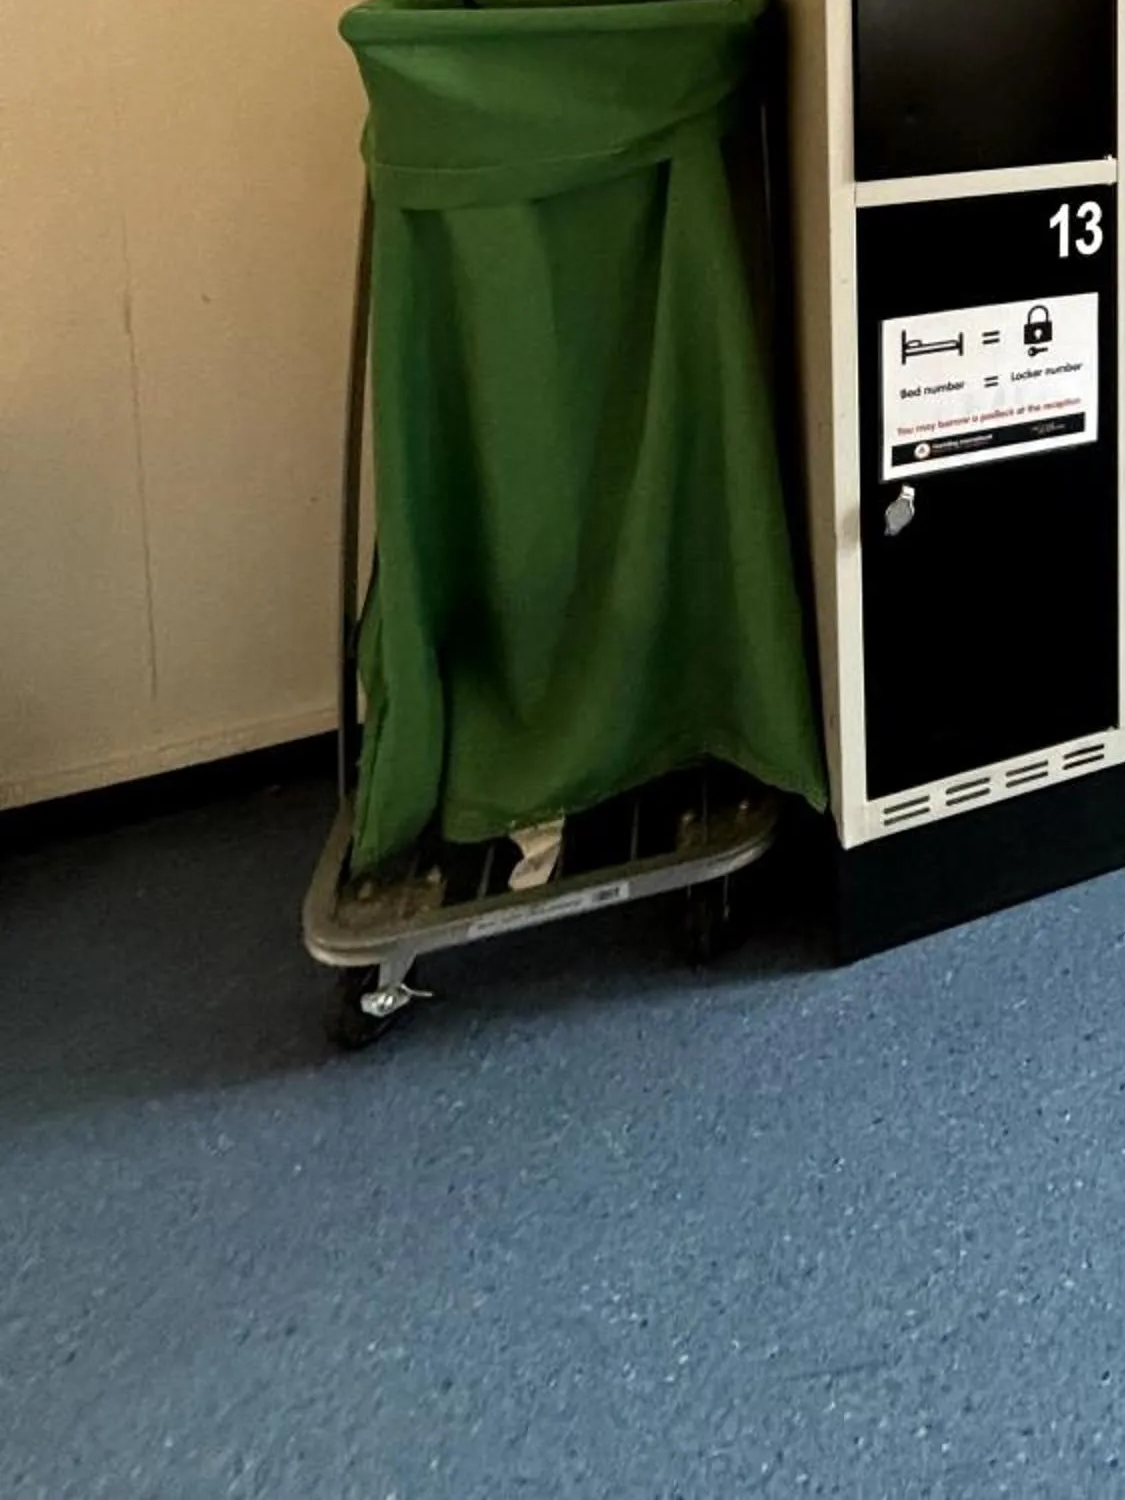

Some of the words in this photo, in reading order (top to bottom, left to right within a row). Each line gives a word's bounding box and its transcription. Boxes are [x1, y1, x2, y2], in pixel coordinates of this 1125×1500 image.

[1049, 201, 1103, 258] 13
[899, 385, 920, 398] Bed
[923, 379, 964, 395] number
[1010, 367, 1041, 381] Locker
[1045, 361, 1082, 376] number
